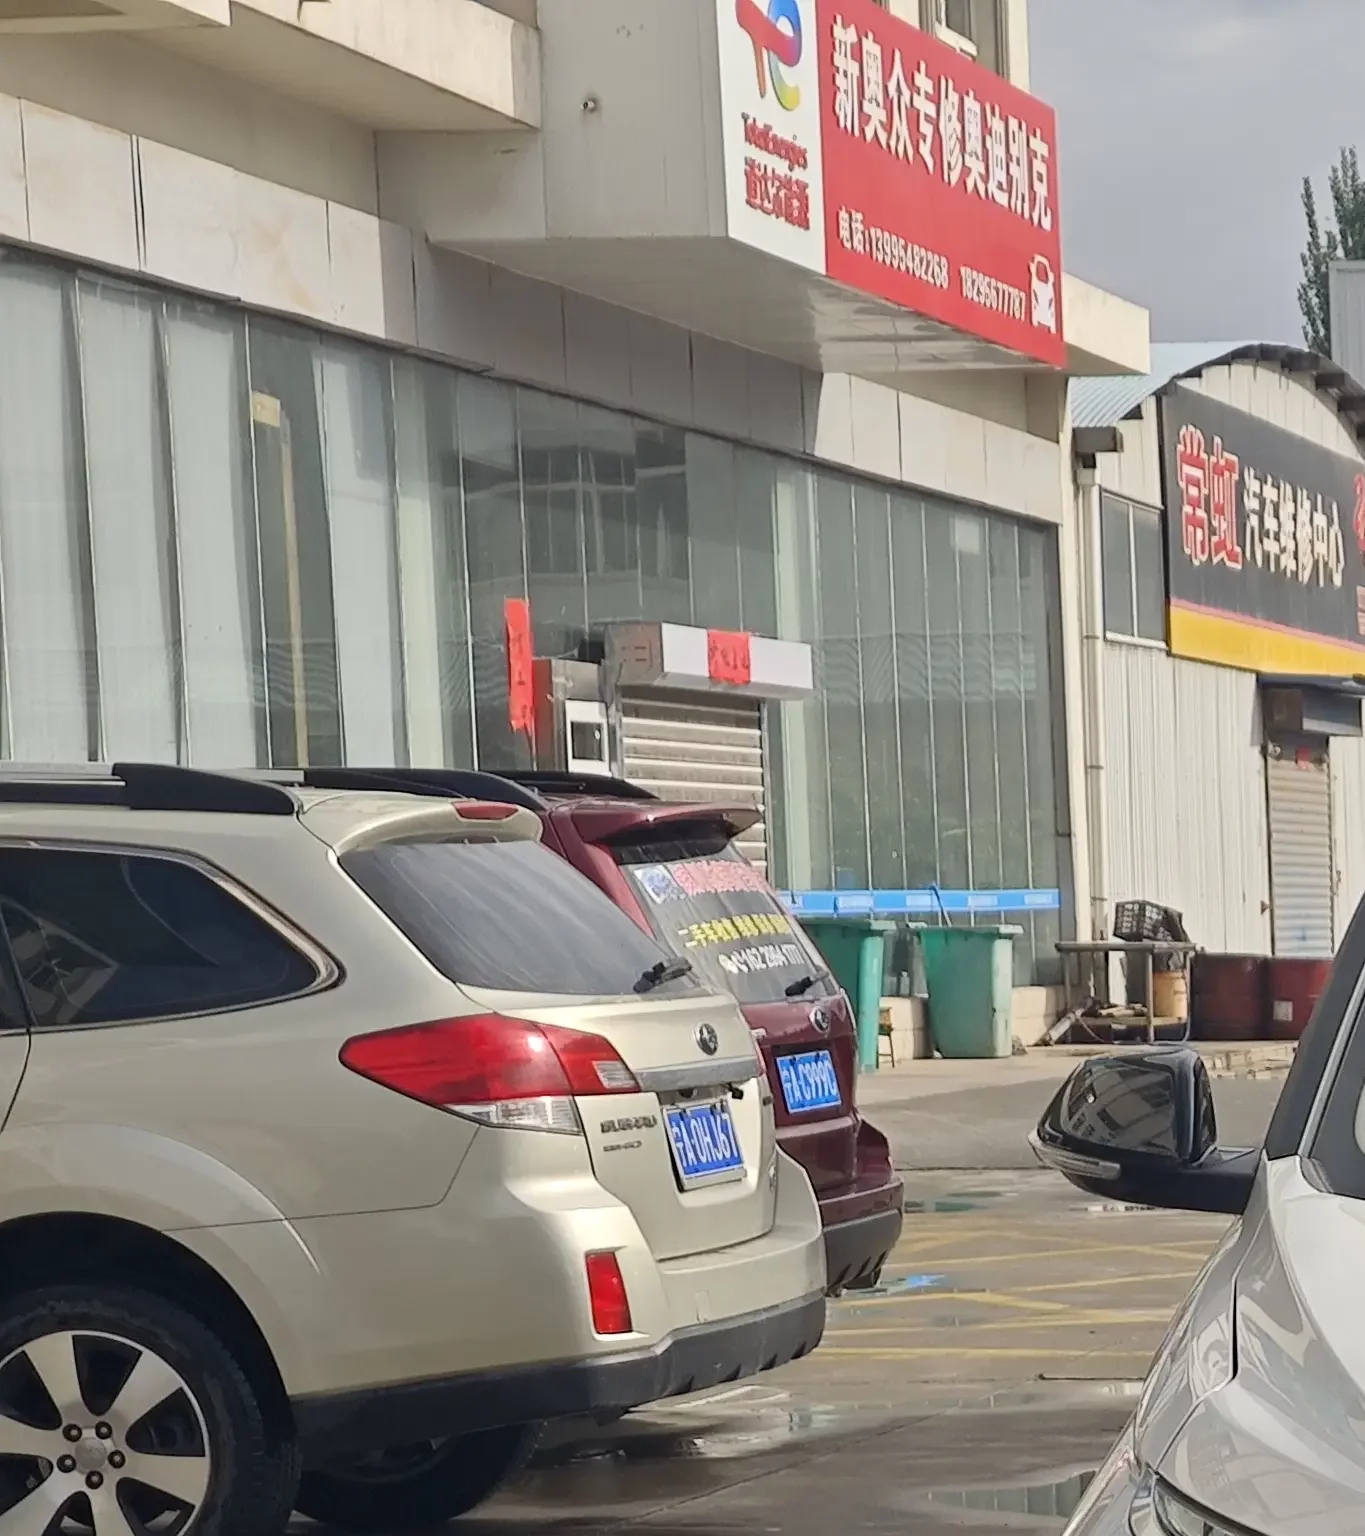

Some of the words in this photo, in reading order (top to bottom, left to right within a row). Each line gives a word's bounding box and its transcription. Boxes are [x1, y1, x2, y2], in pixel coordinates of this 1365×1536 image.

[832, 13, 1052, 231] 新奥众专修奥迪别克
[1244, 465, 1345, 589] 汽车维修中心
